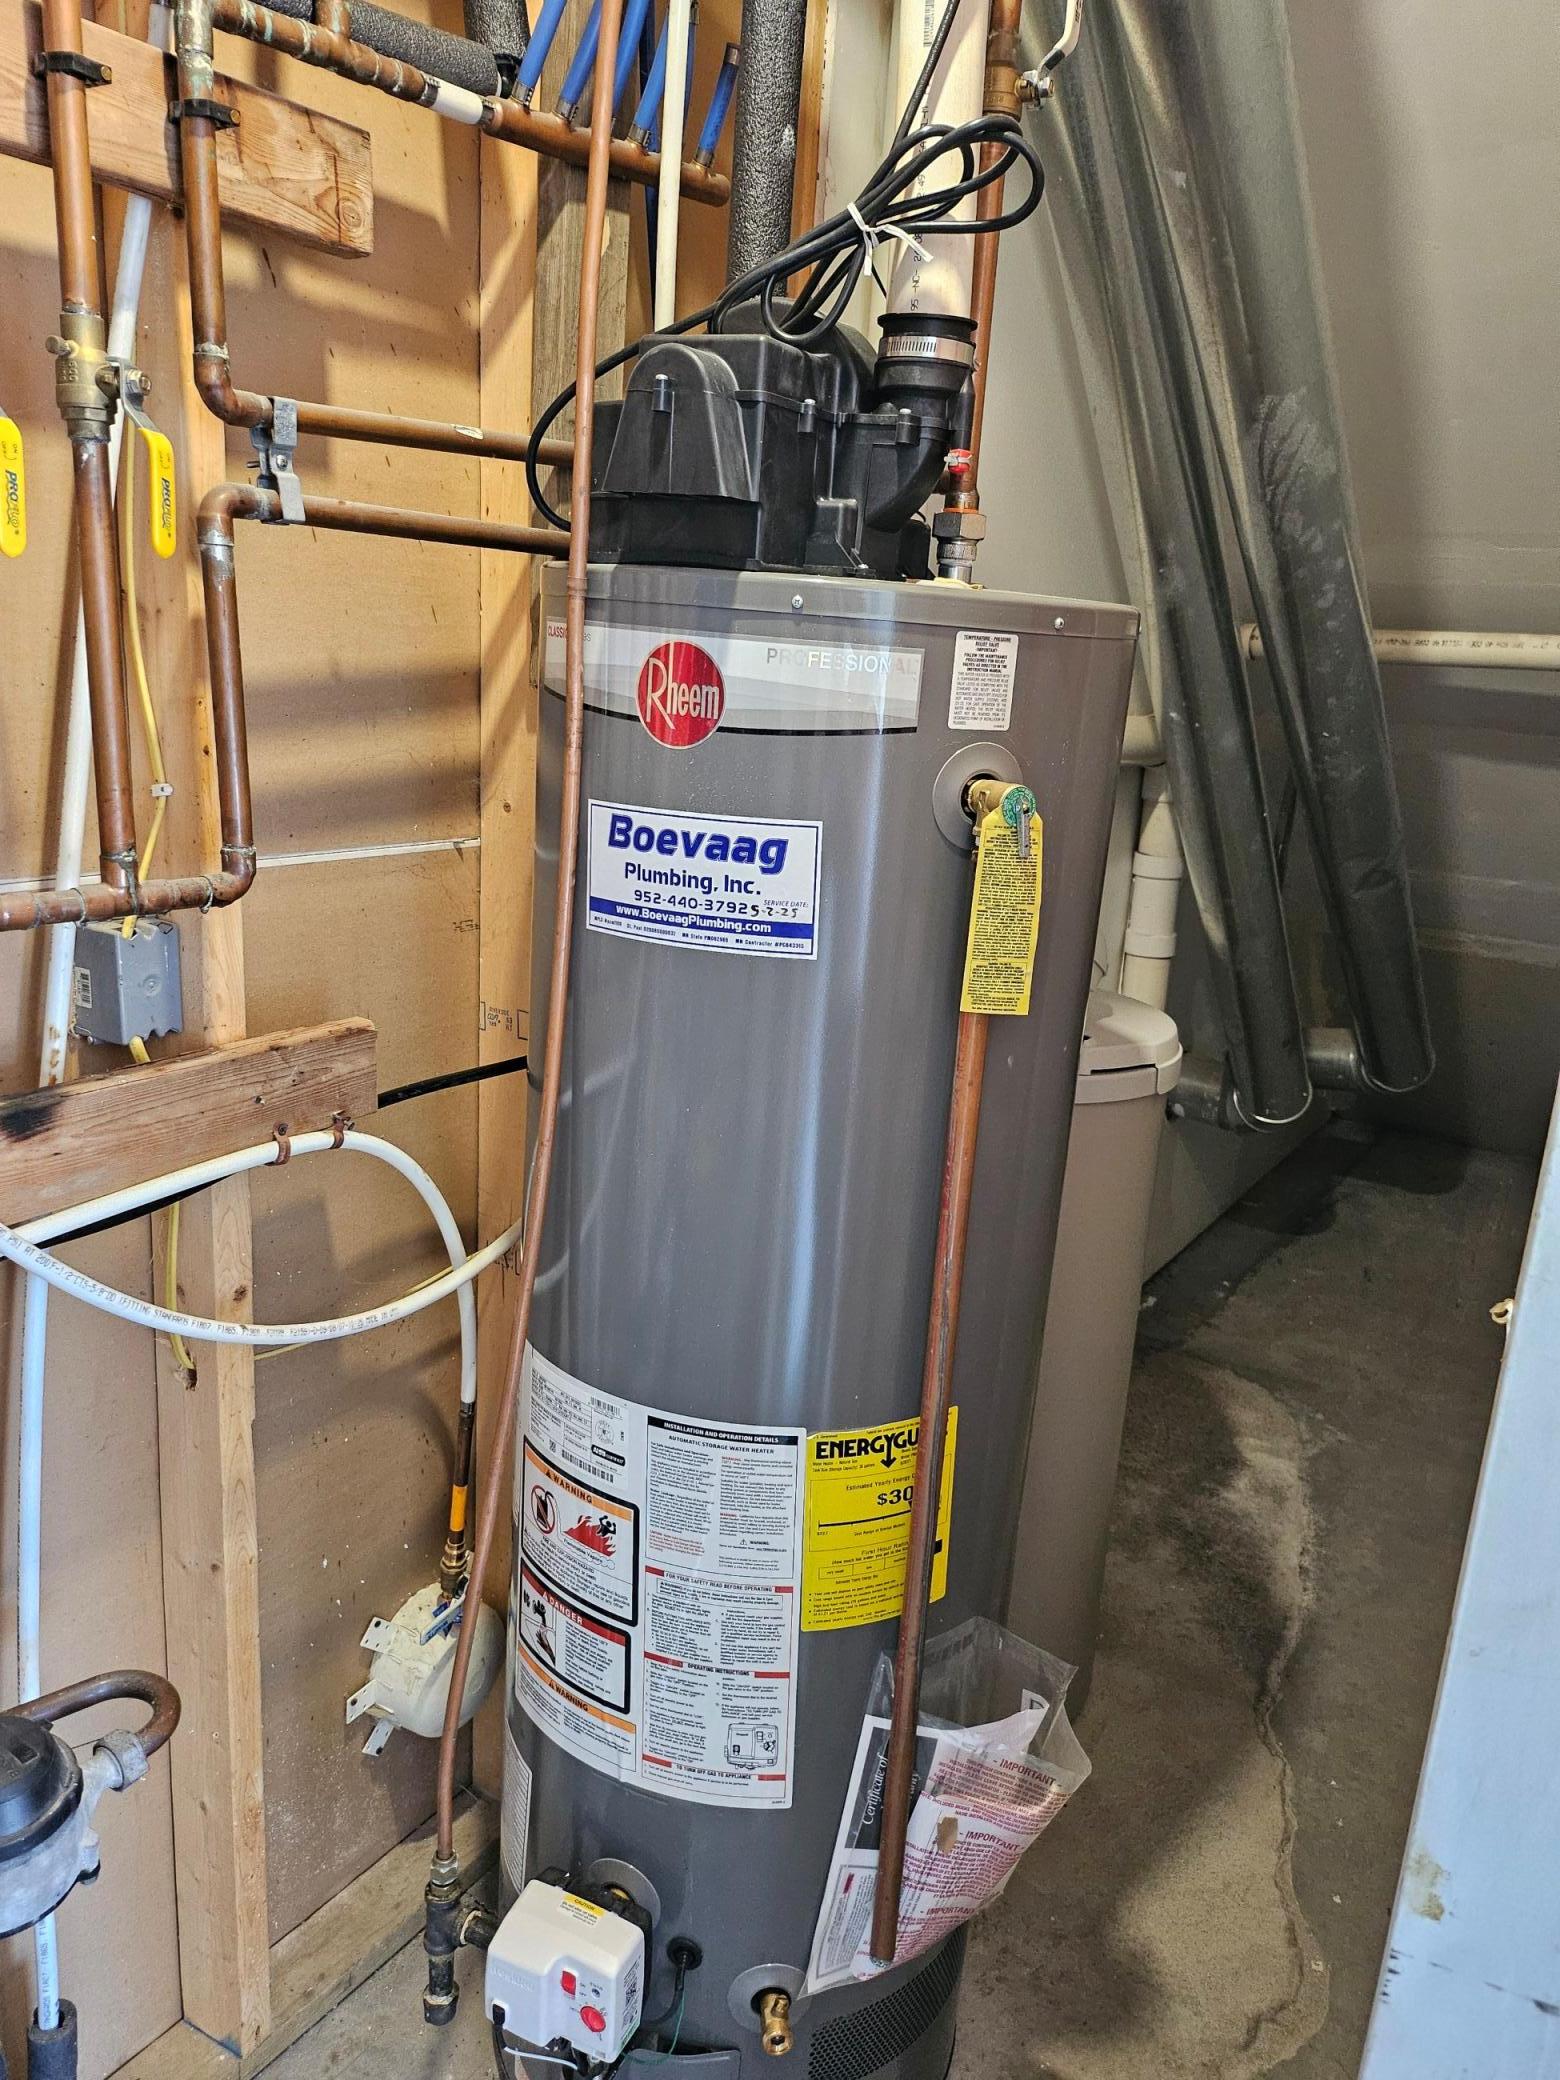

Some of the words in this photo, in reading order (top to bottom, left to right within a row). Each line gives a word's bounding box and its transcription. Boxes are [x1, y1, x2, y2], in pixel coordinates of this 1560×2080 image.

[767, 647, 918, 676] PROFESSIONAL
[646, 641, 719, 731] Rheem
[608, 813, 789, 875] Boevaag
[624, 862, 719, 895] Plumbing,
[724, 874, 761, 895] Inc.
[634, 889, 747, 915] 952-440-3792
[764, 899, 788, 908] SERVICE
[615, 904, 772, 934] www.BoevaagPlumbing.com
[745, 939, 773, 947] Contractor
[664, 1422, 704, 1435] INSTALLATION
[705, 1430, 718, 1438] AND
[718, 1432, 752, 1441] OPERATION
[668, 1435, 701, 1446] AUTOMATIC
[702, 1442, 728, 1450] STORAGE
[816, 1427, 919, 1466] ENERGYGU
[554, 1475, 592, 1503] WARNING
[847, 1482, 873, 1491] Estimated
[893, 1474, 911, 1483] Energy
[587, 1552, 602, 1564] Vapors
[691, 1577, 709, 1585] SAFETY
[550, 1599, 583, 1625] DANGER
[688, 1663, 714, 1672] OPERATING
[715, 1667, 750, 1676] INSTRUCTIONS
[554, 1685, 588, 1712] WARNING
[725, 1772, 751, 1780] APPLIANCE
[1000, 1758, 1056, 1786] IMPORTANT
[862, 1769, 885, 1825] Certificate
[877, 1752, 889, 1768] of
[966, 1830, 1019, 1851] IMPORTANT
[574, 1898, 595, 1911] CAUTION
